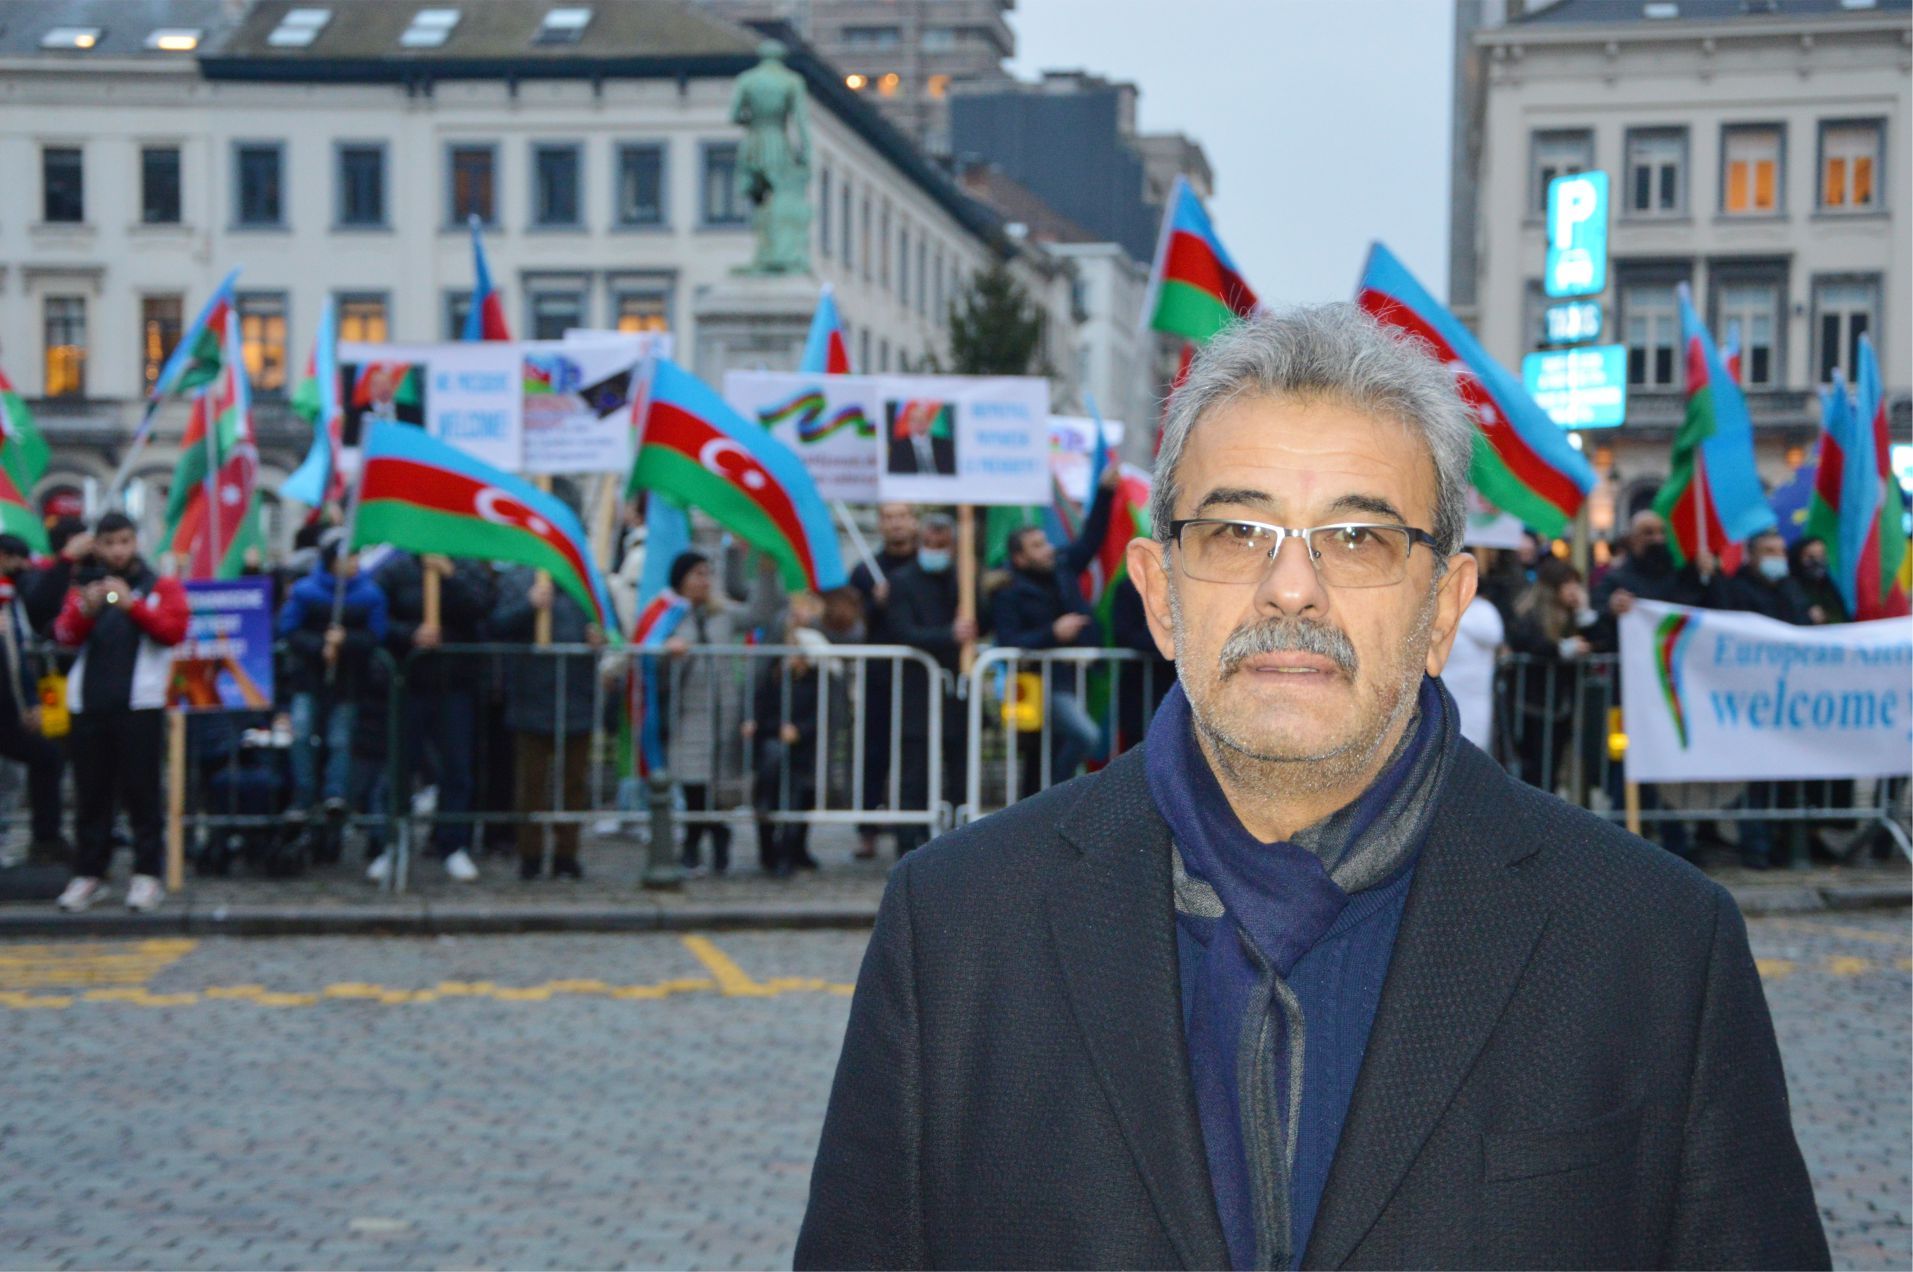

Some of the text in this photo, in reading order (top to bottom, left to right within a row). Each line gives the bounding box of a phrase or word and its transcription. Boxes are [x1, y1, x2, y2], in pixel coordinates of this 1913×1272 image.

[1555, 178, 1597, 250] P
[1714, 633, 1845, 672] European
[1710, 679, 1898, 728] welcome
